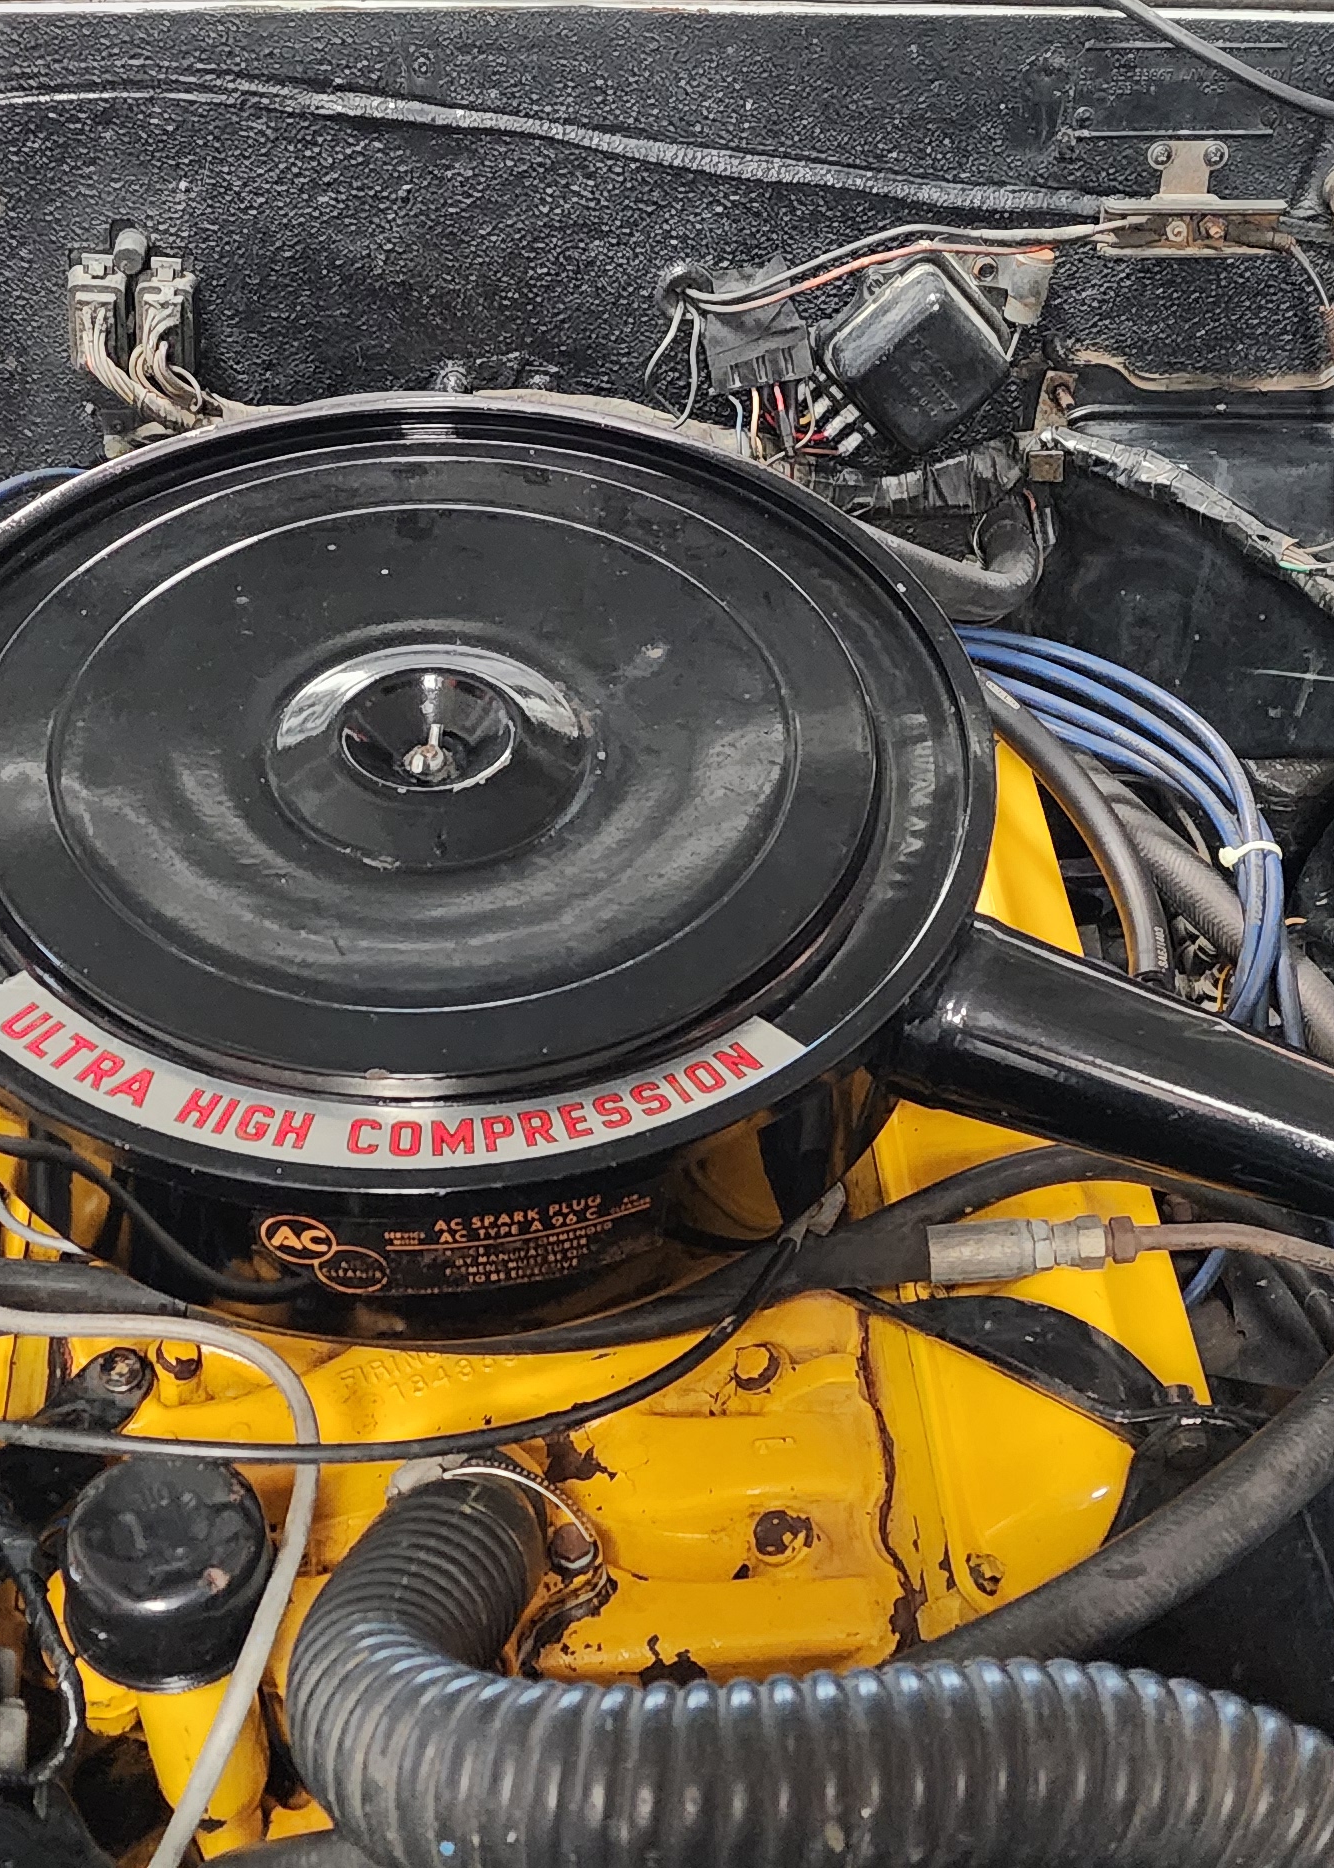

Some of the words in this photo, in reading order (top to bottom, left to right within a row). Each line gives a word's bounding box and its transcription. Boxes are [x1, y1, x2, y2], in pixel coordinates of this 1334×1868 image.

[0, 1001, 157, 1109] ULTRA
[172, 1088, 319, 1151] HIGH
[347, 1041, 766, 1158] COMPRESSION
[434, 1218, 464, 1232] AC
[470, 1208, 540, 1229] SPARK
[548, 1193, 602, 1217] PLUG
[438, 1230, 468, 1244] AC
[478, 1224, 520, 1239] TYPE
[529, 1219, 544, 1232] A
[551, 1214, 578, 1228] 96
[585, 1206, 600, 1219] C
[269, 1225, 329, 1252] AC
